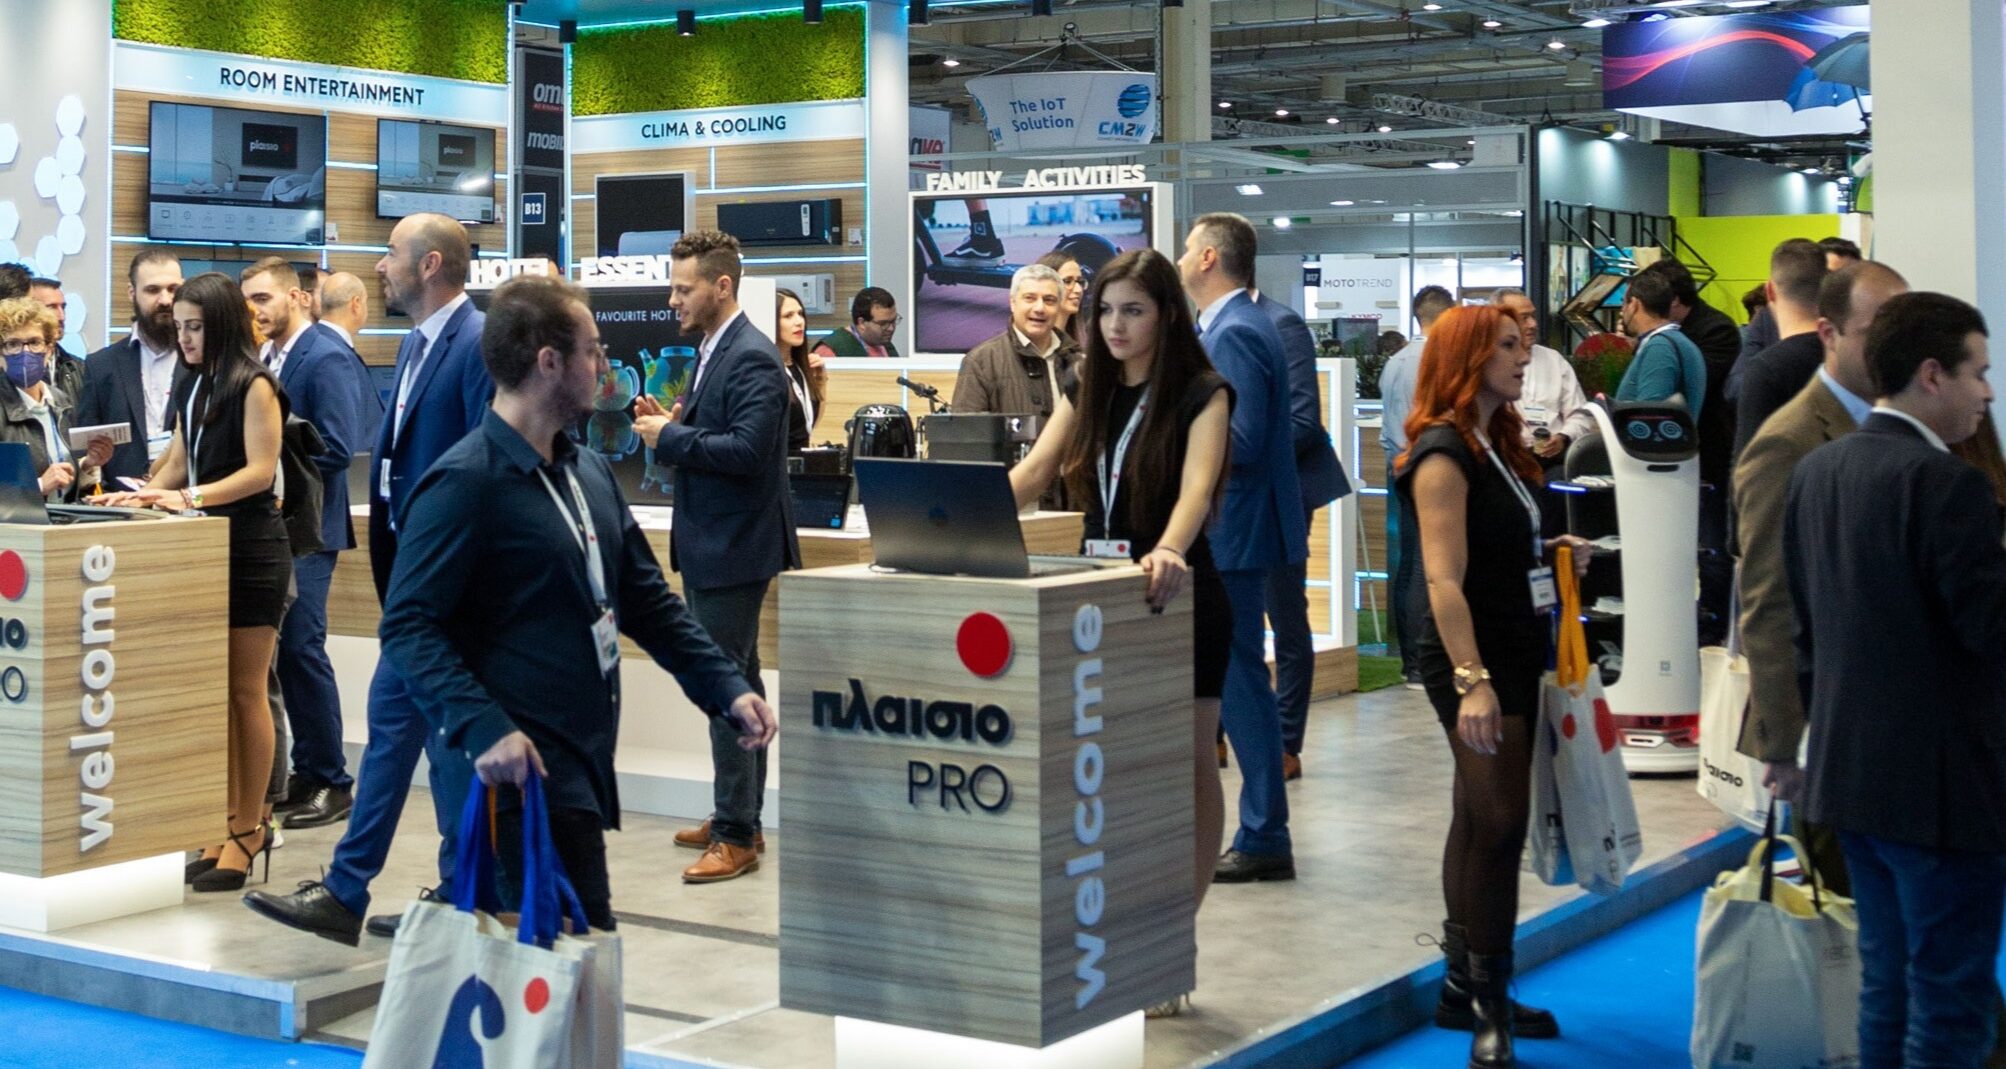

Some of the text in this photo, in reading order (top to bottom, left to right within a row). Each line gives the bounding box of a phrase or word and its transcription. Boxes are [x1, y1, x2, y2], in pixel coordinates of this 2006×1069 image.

[220, 67, 424, 105] ROOM ENTERTAINMENT
[1009, 98, 1066, 114] The IoT
[641, 115, 786, 138] CLIMA & COOLING
[1012, 115, 1074, 133] Solution
[1098, 121, 1146, 137] CM2W
[926, 164, 1146, 191] FAMILY ACTIVITIES
[525, 203, 541, 215] B13
[1324, 279, 1392, 288] MOTOTREND
[596, 311, 647, 322] FAVOURITE
[651, 310, 672, 321] HOT
[70, 543, 115, 852] welcome
[812, 678, 1010, 744] πλαισιο
[907, 760, 1009, 813] PRO
[1066, 603, 1105, 1009] welcome
